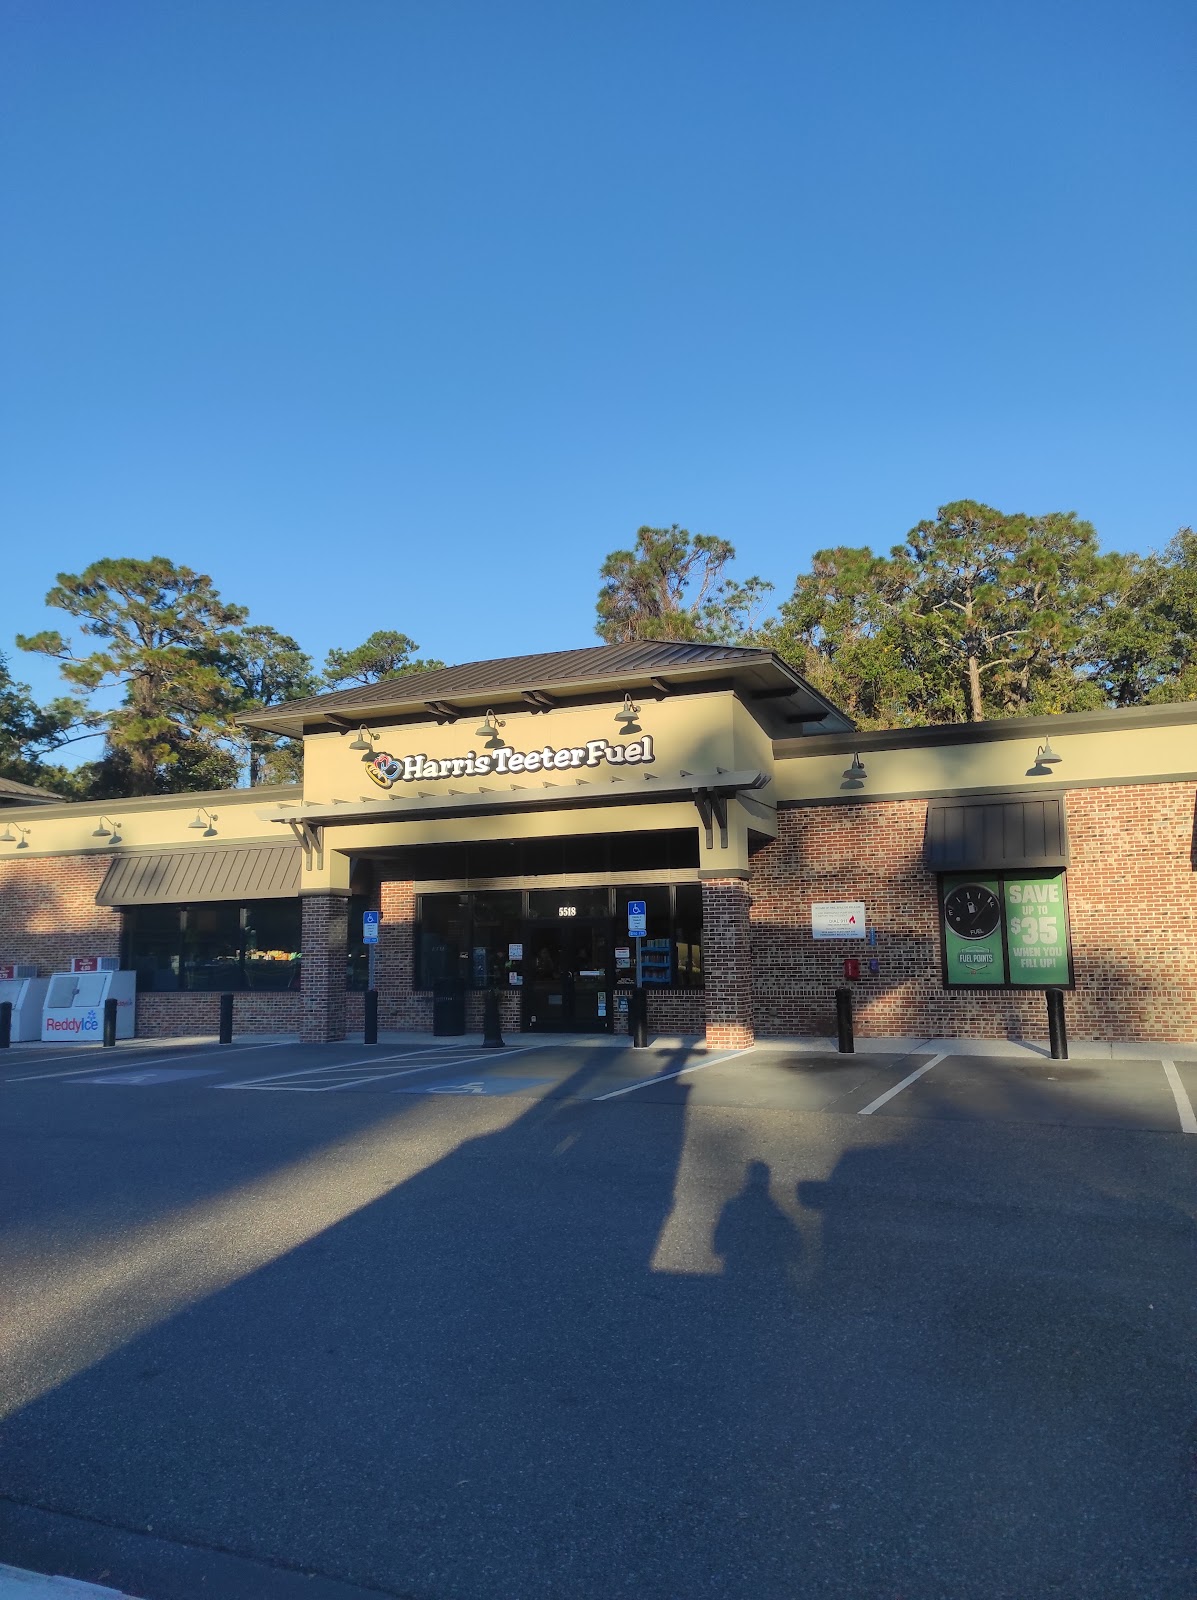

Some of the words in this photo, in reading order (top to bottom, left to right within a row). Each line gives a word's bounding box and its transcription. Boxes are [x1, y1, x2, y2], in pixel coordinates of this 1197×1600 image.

[402, 753, 492, 781] Harris
[492, 747, 586, 772] Teeter
[586, 736, 655, 765] Fuel
[1009, 884, 1059, 904] SAVE
[558, 907, 576, 917] 5518
[1022, 906, 1034, 915] UP
[1037, 905, 1048, 915] TO
[1010, 916, 1058, 945] $35
[1013, 948, 1041, 957] WHEN
[1042, 947, 1063, 957] YOU
[959, 954, 972, 963] FUEL
[973, 953, 993, 963] POINTS
[1020, 958, 1038, 968] FILL
[1039, 958, 1056, 967] UP!
